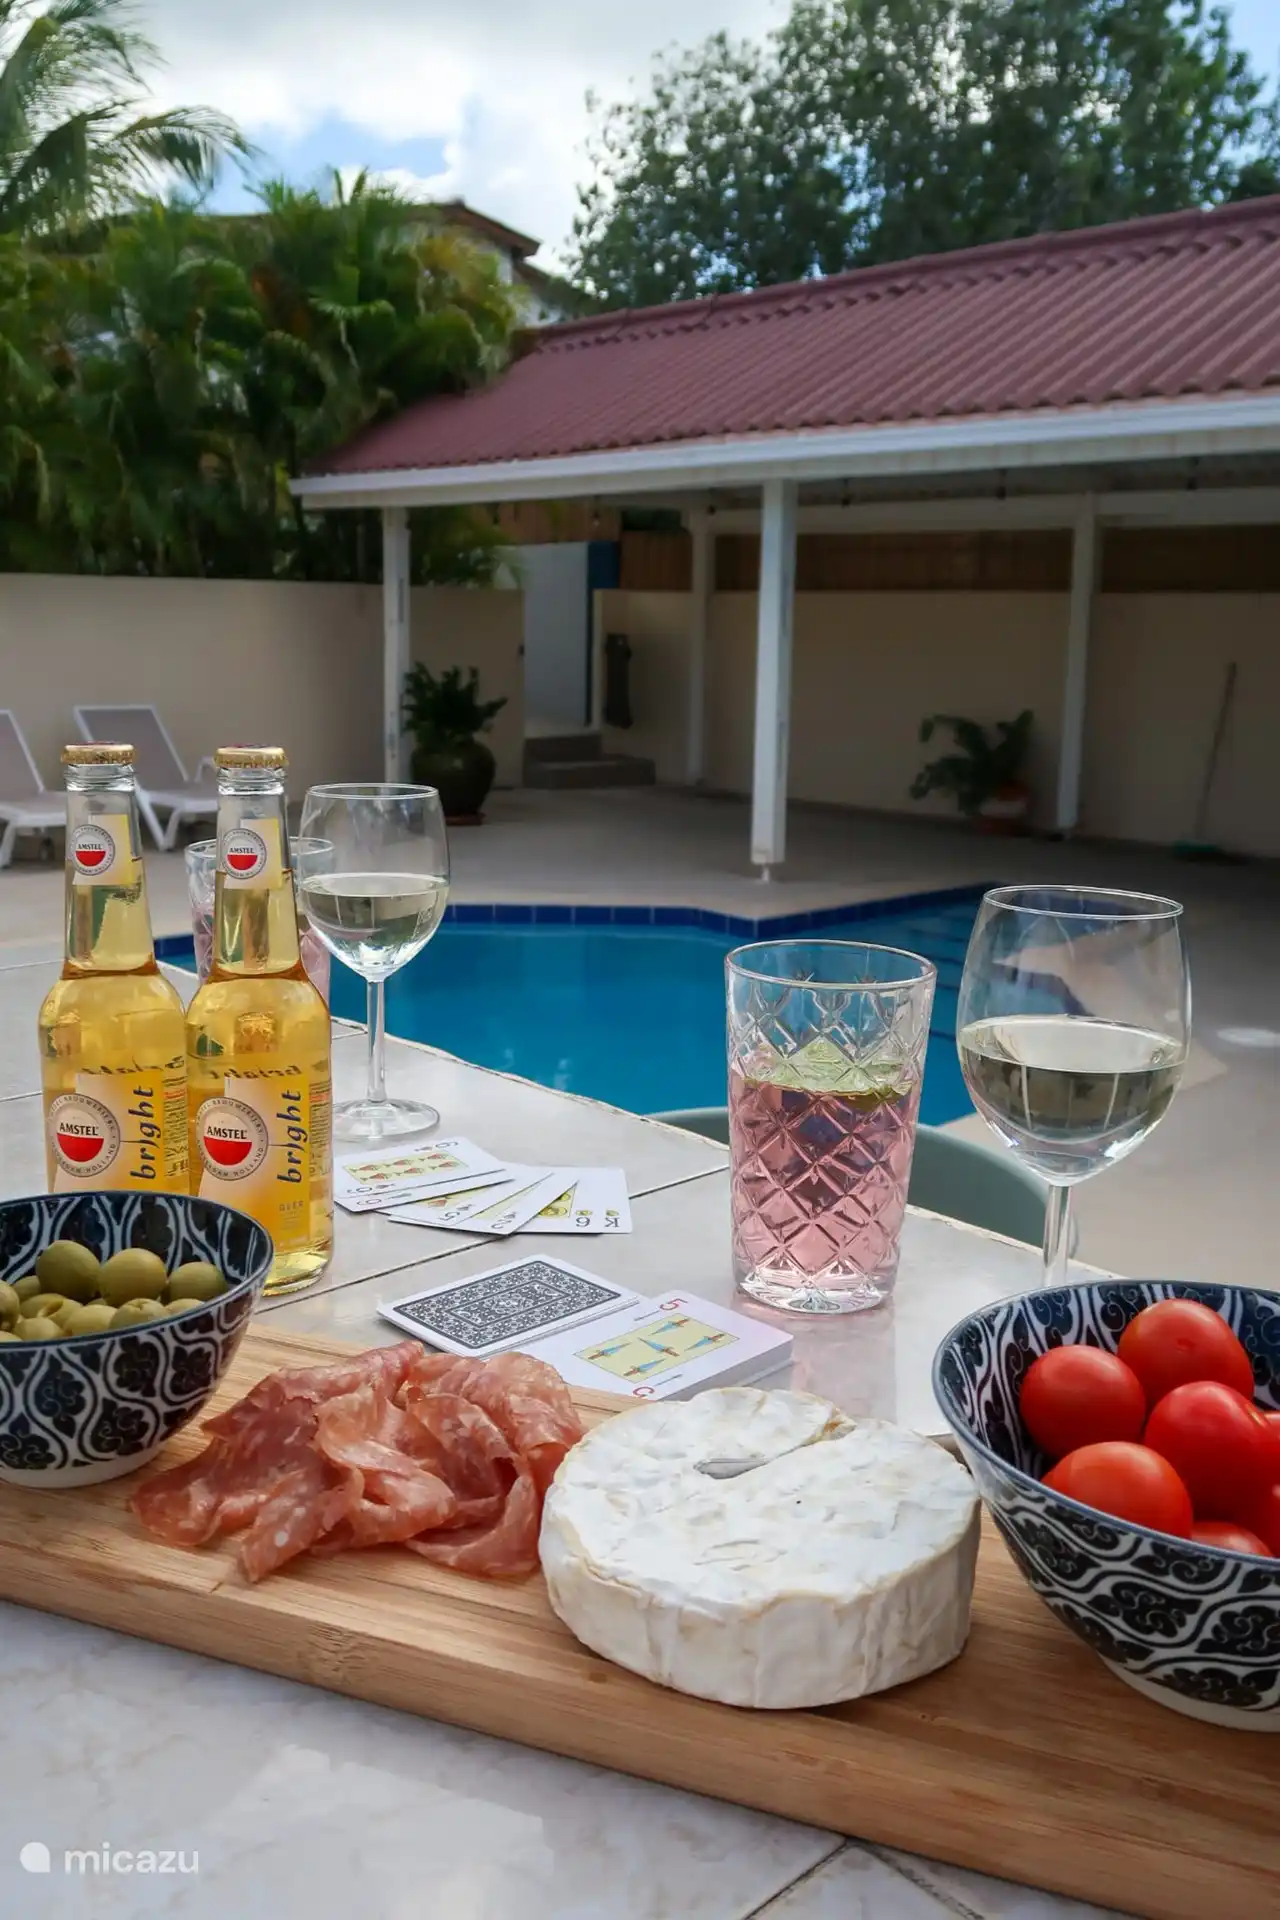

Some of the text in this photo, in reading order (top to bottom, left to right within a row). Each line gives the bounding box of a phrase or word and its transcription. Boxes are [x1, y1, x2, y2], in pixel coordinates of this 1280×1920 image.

[59, 1122, 99, 1136] AMSTEL
[127, 1085, 161, 1180] bright
[207, 1126, 247, 1140] AMSTEL
[276, 1089, 308, 1183] bright
[605, 1217, 621, 1228] K
[660, 1298, 688, 1310] 5
